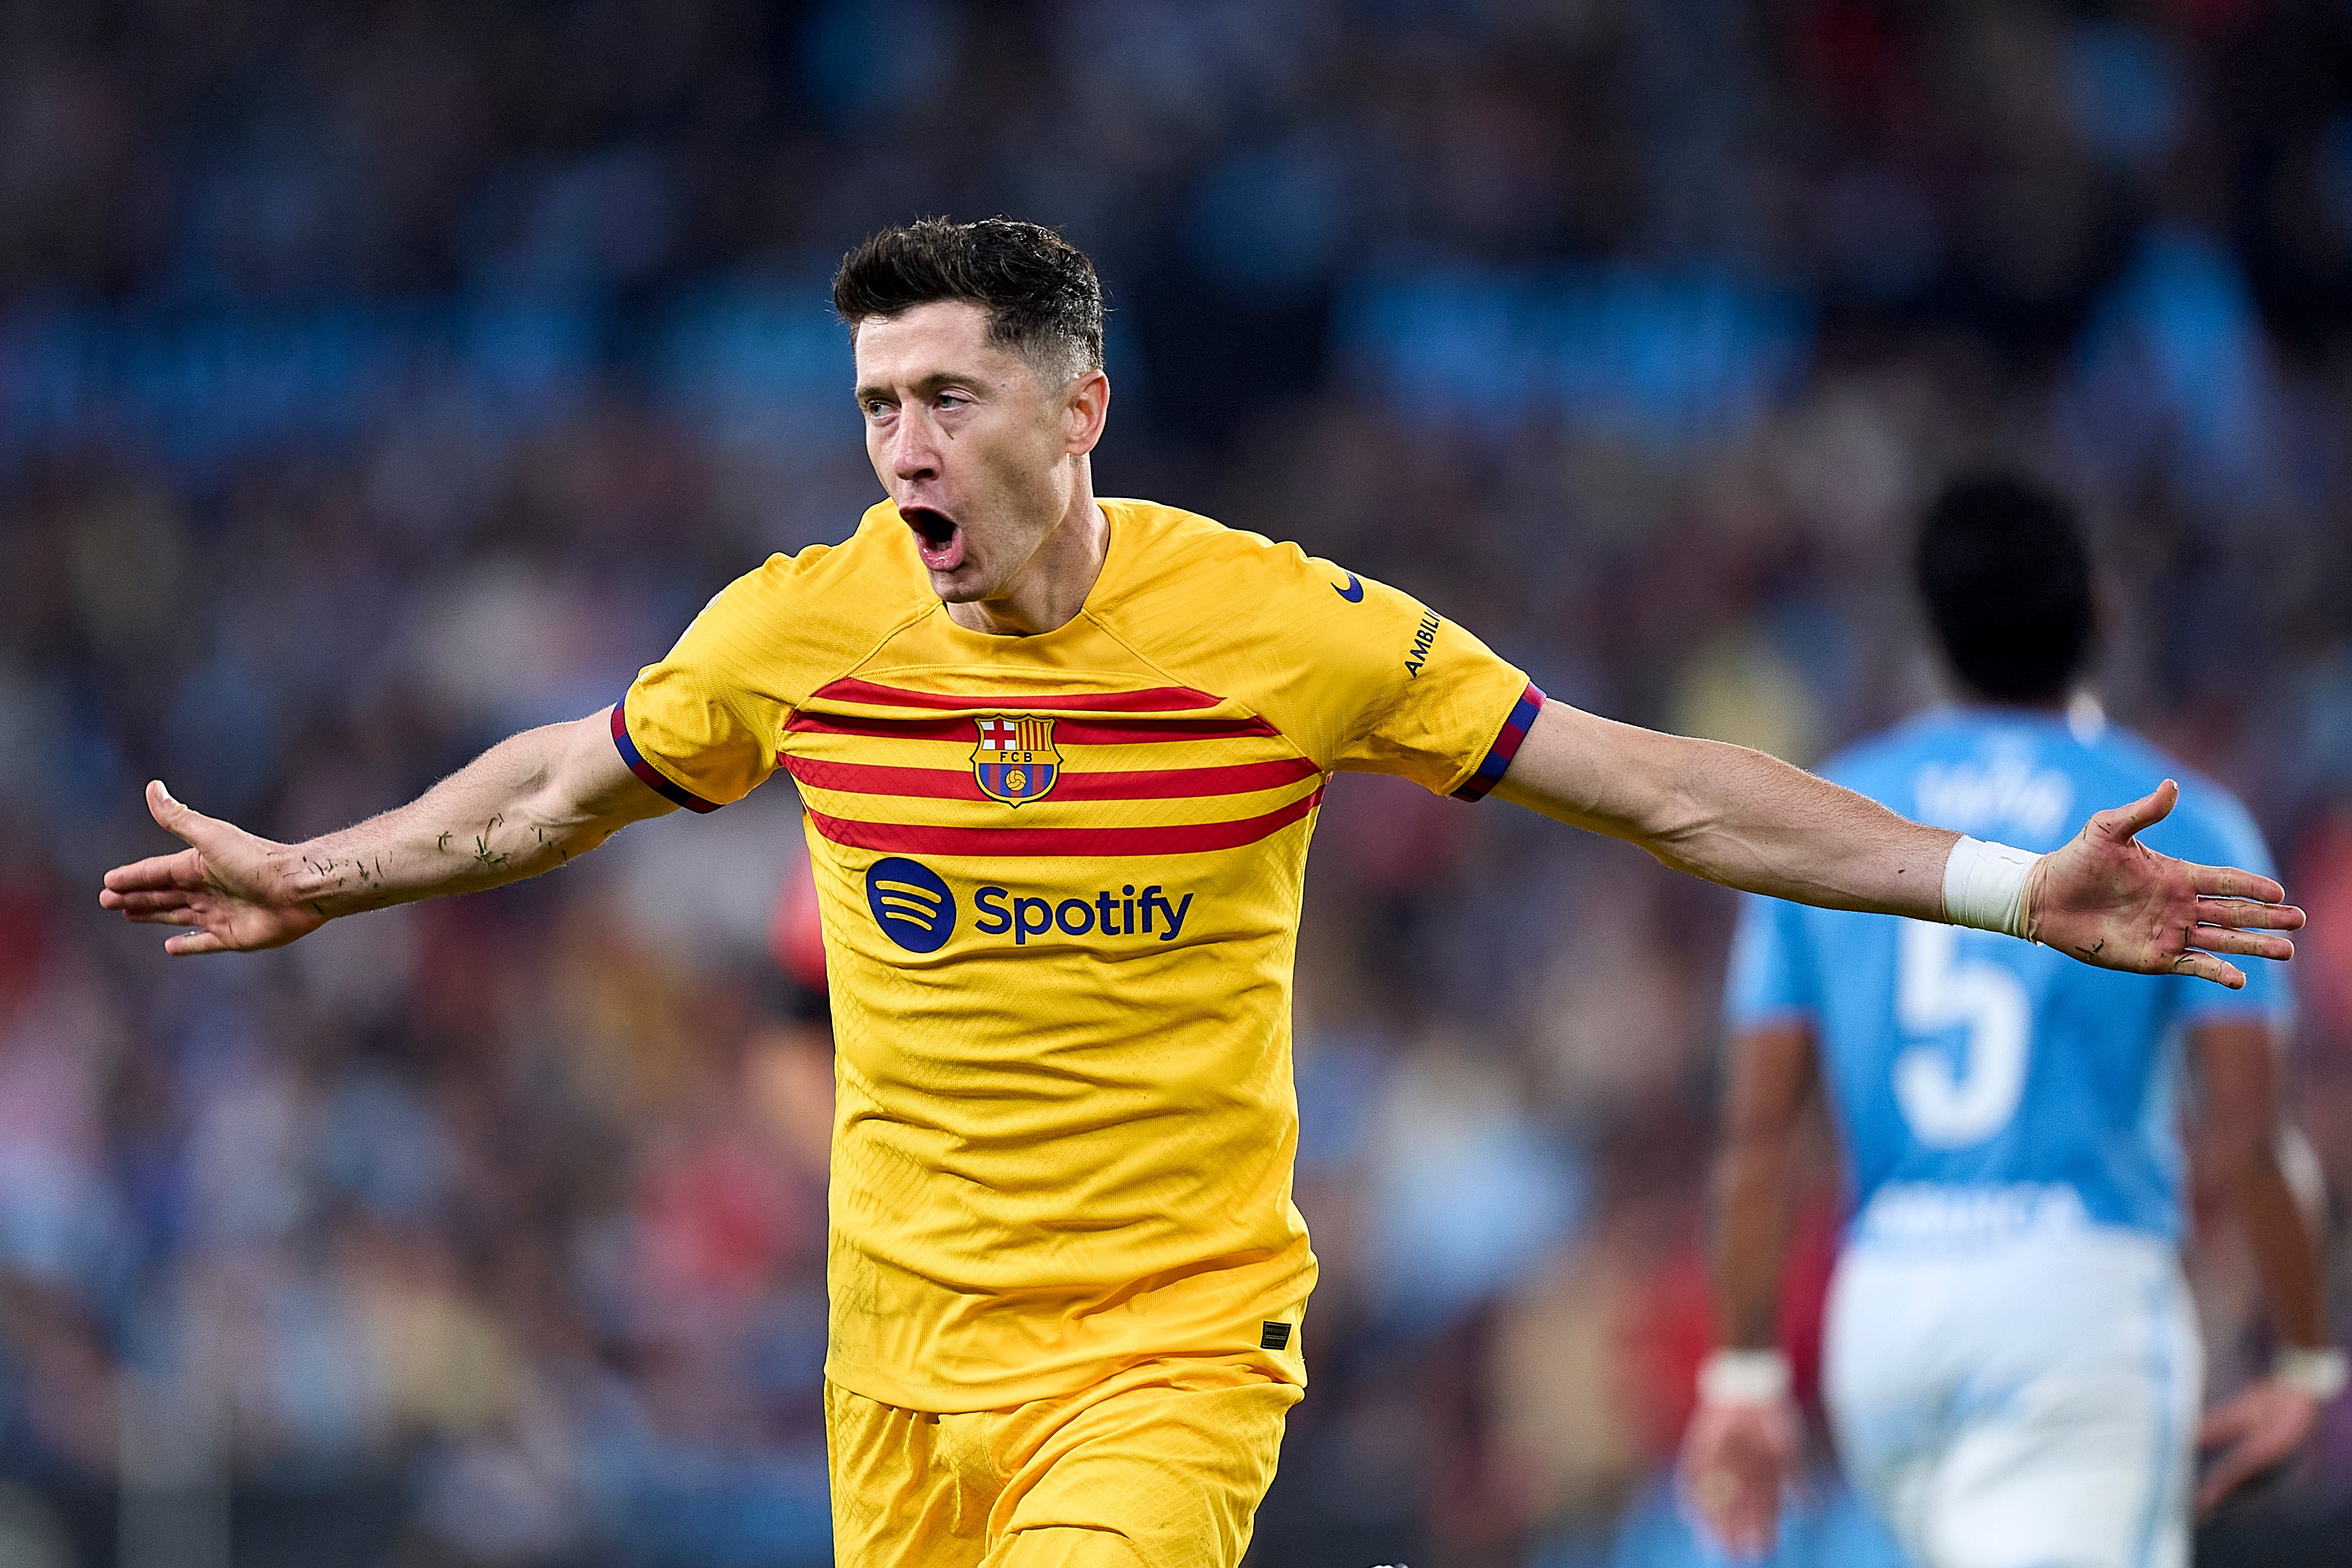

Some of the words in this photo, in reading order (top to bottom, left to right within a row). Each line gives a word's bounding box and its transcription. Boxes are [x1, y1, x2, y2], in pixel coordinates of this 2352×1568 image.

[1404, 608, 1440, 678] AMBILI
[974, 884, 1194, 946] Spotify
[1893, 916, 2032, 1148] 5
